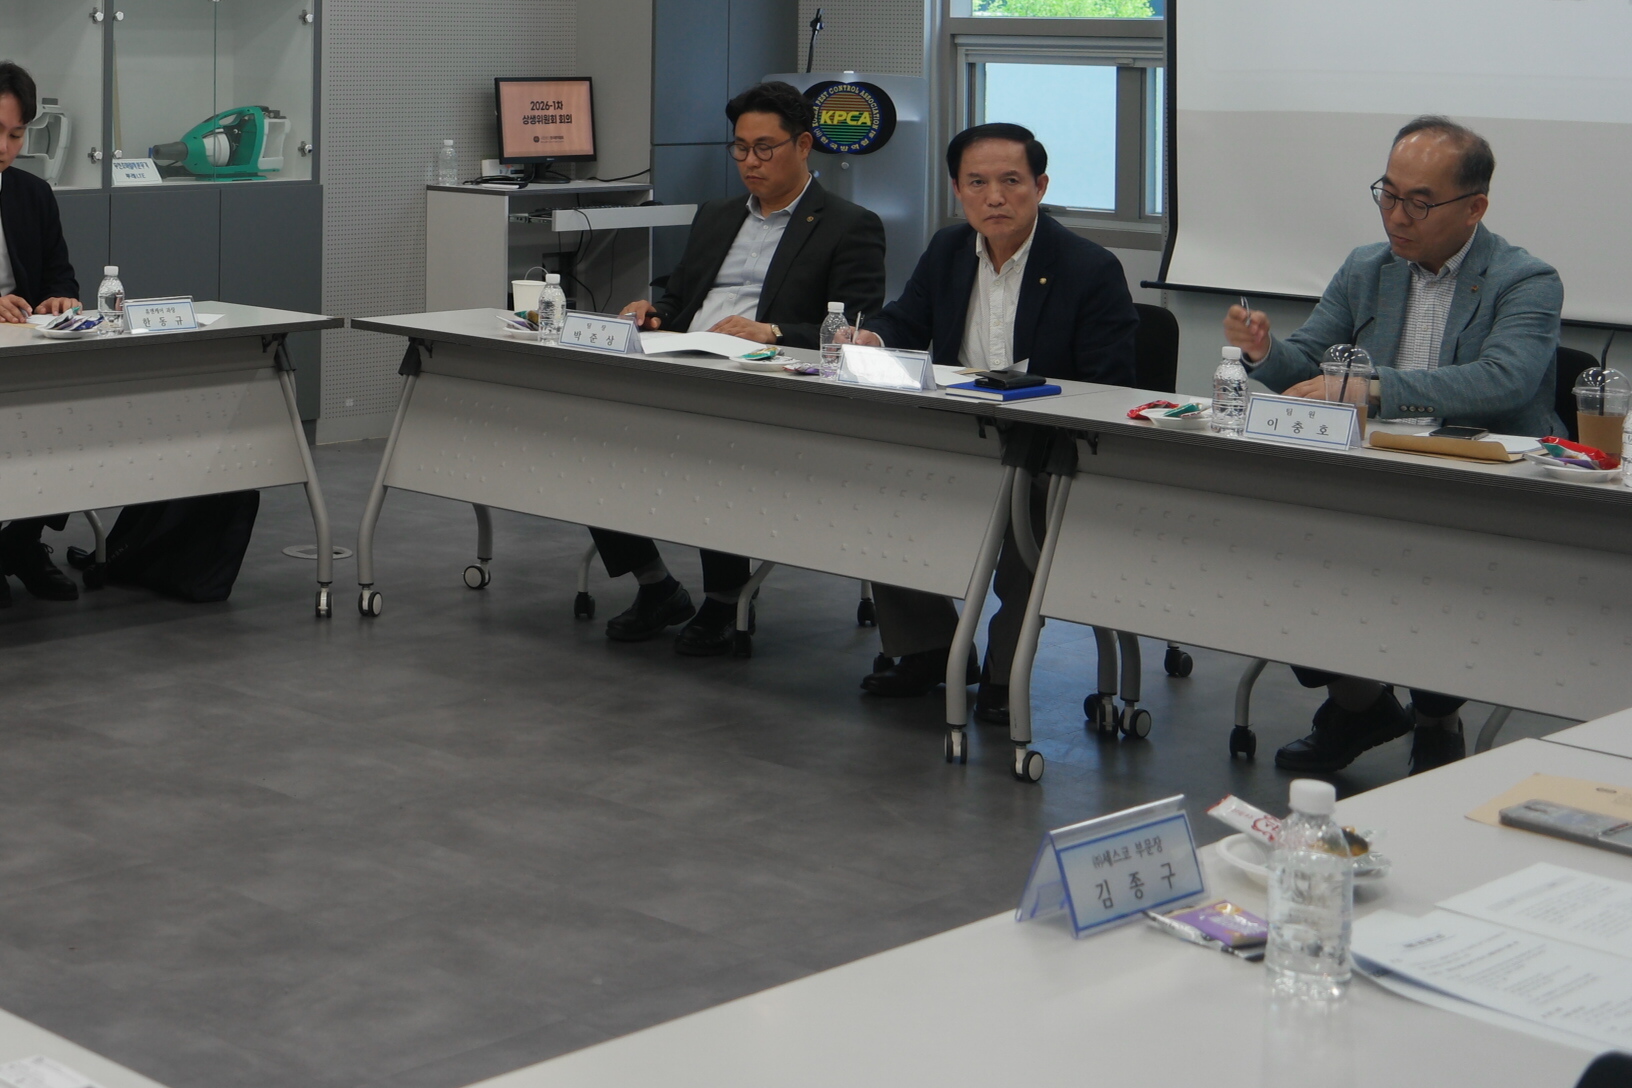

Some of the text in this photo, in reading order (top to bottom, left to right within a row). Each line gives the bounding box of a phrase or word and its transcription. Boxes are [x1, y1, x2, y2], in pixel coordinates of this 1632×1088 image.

[530, 101, 563, 111] 2026-1차
[815, 91, 829, 106] PEST
[828, 84, 860, 94] CONTROL
[859, 90, 880, 130] ASSOCIATION
[522, 114, 573, 125] 상생위원회 회의
[819, 110, 872, 126] KPCA
[1134, 835, 1163, 859] 부문장
